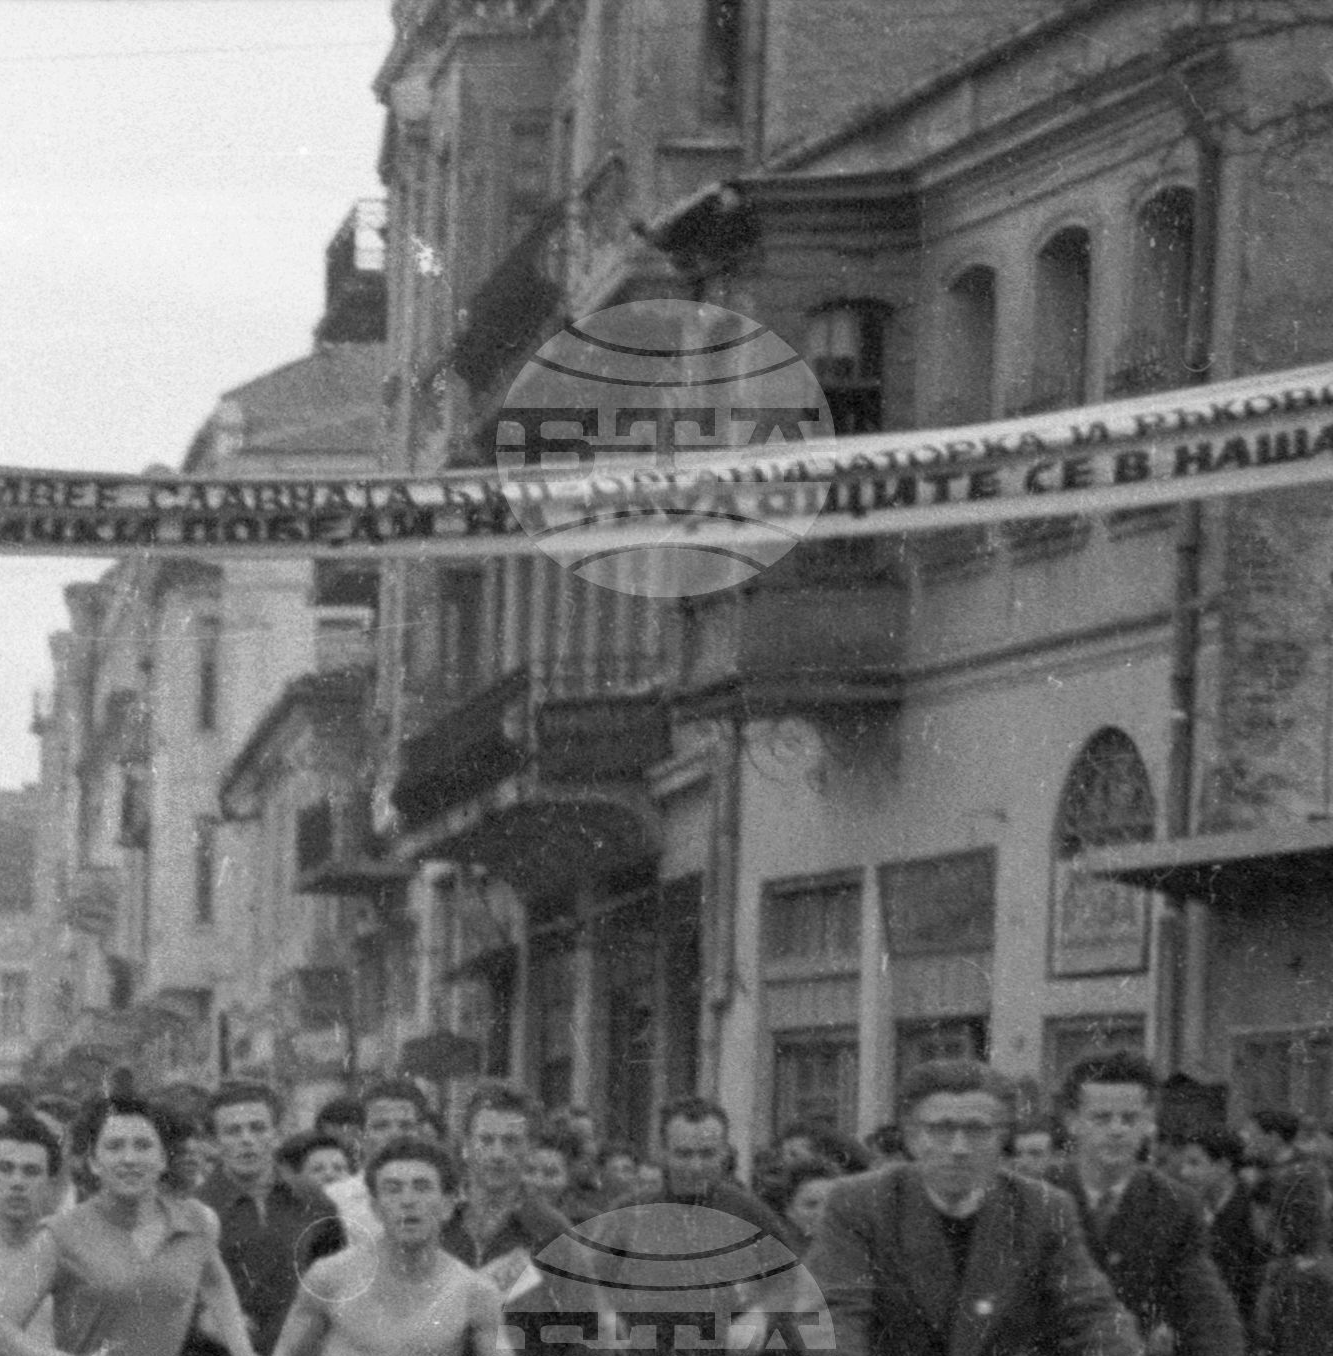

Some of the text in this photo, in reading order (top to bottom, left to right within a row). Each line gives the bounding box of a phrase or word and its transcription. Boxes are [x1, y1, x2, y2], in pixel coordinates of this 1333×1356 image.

[150, 477, 411, 511] СЛАВНАТА
[179, 509, 435, 547] ПОБЕДИ
[1023, 455, 1093, 496] СЕ
[1113, 451, 1151, 484] В
